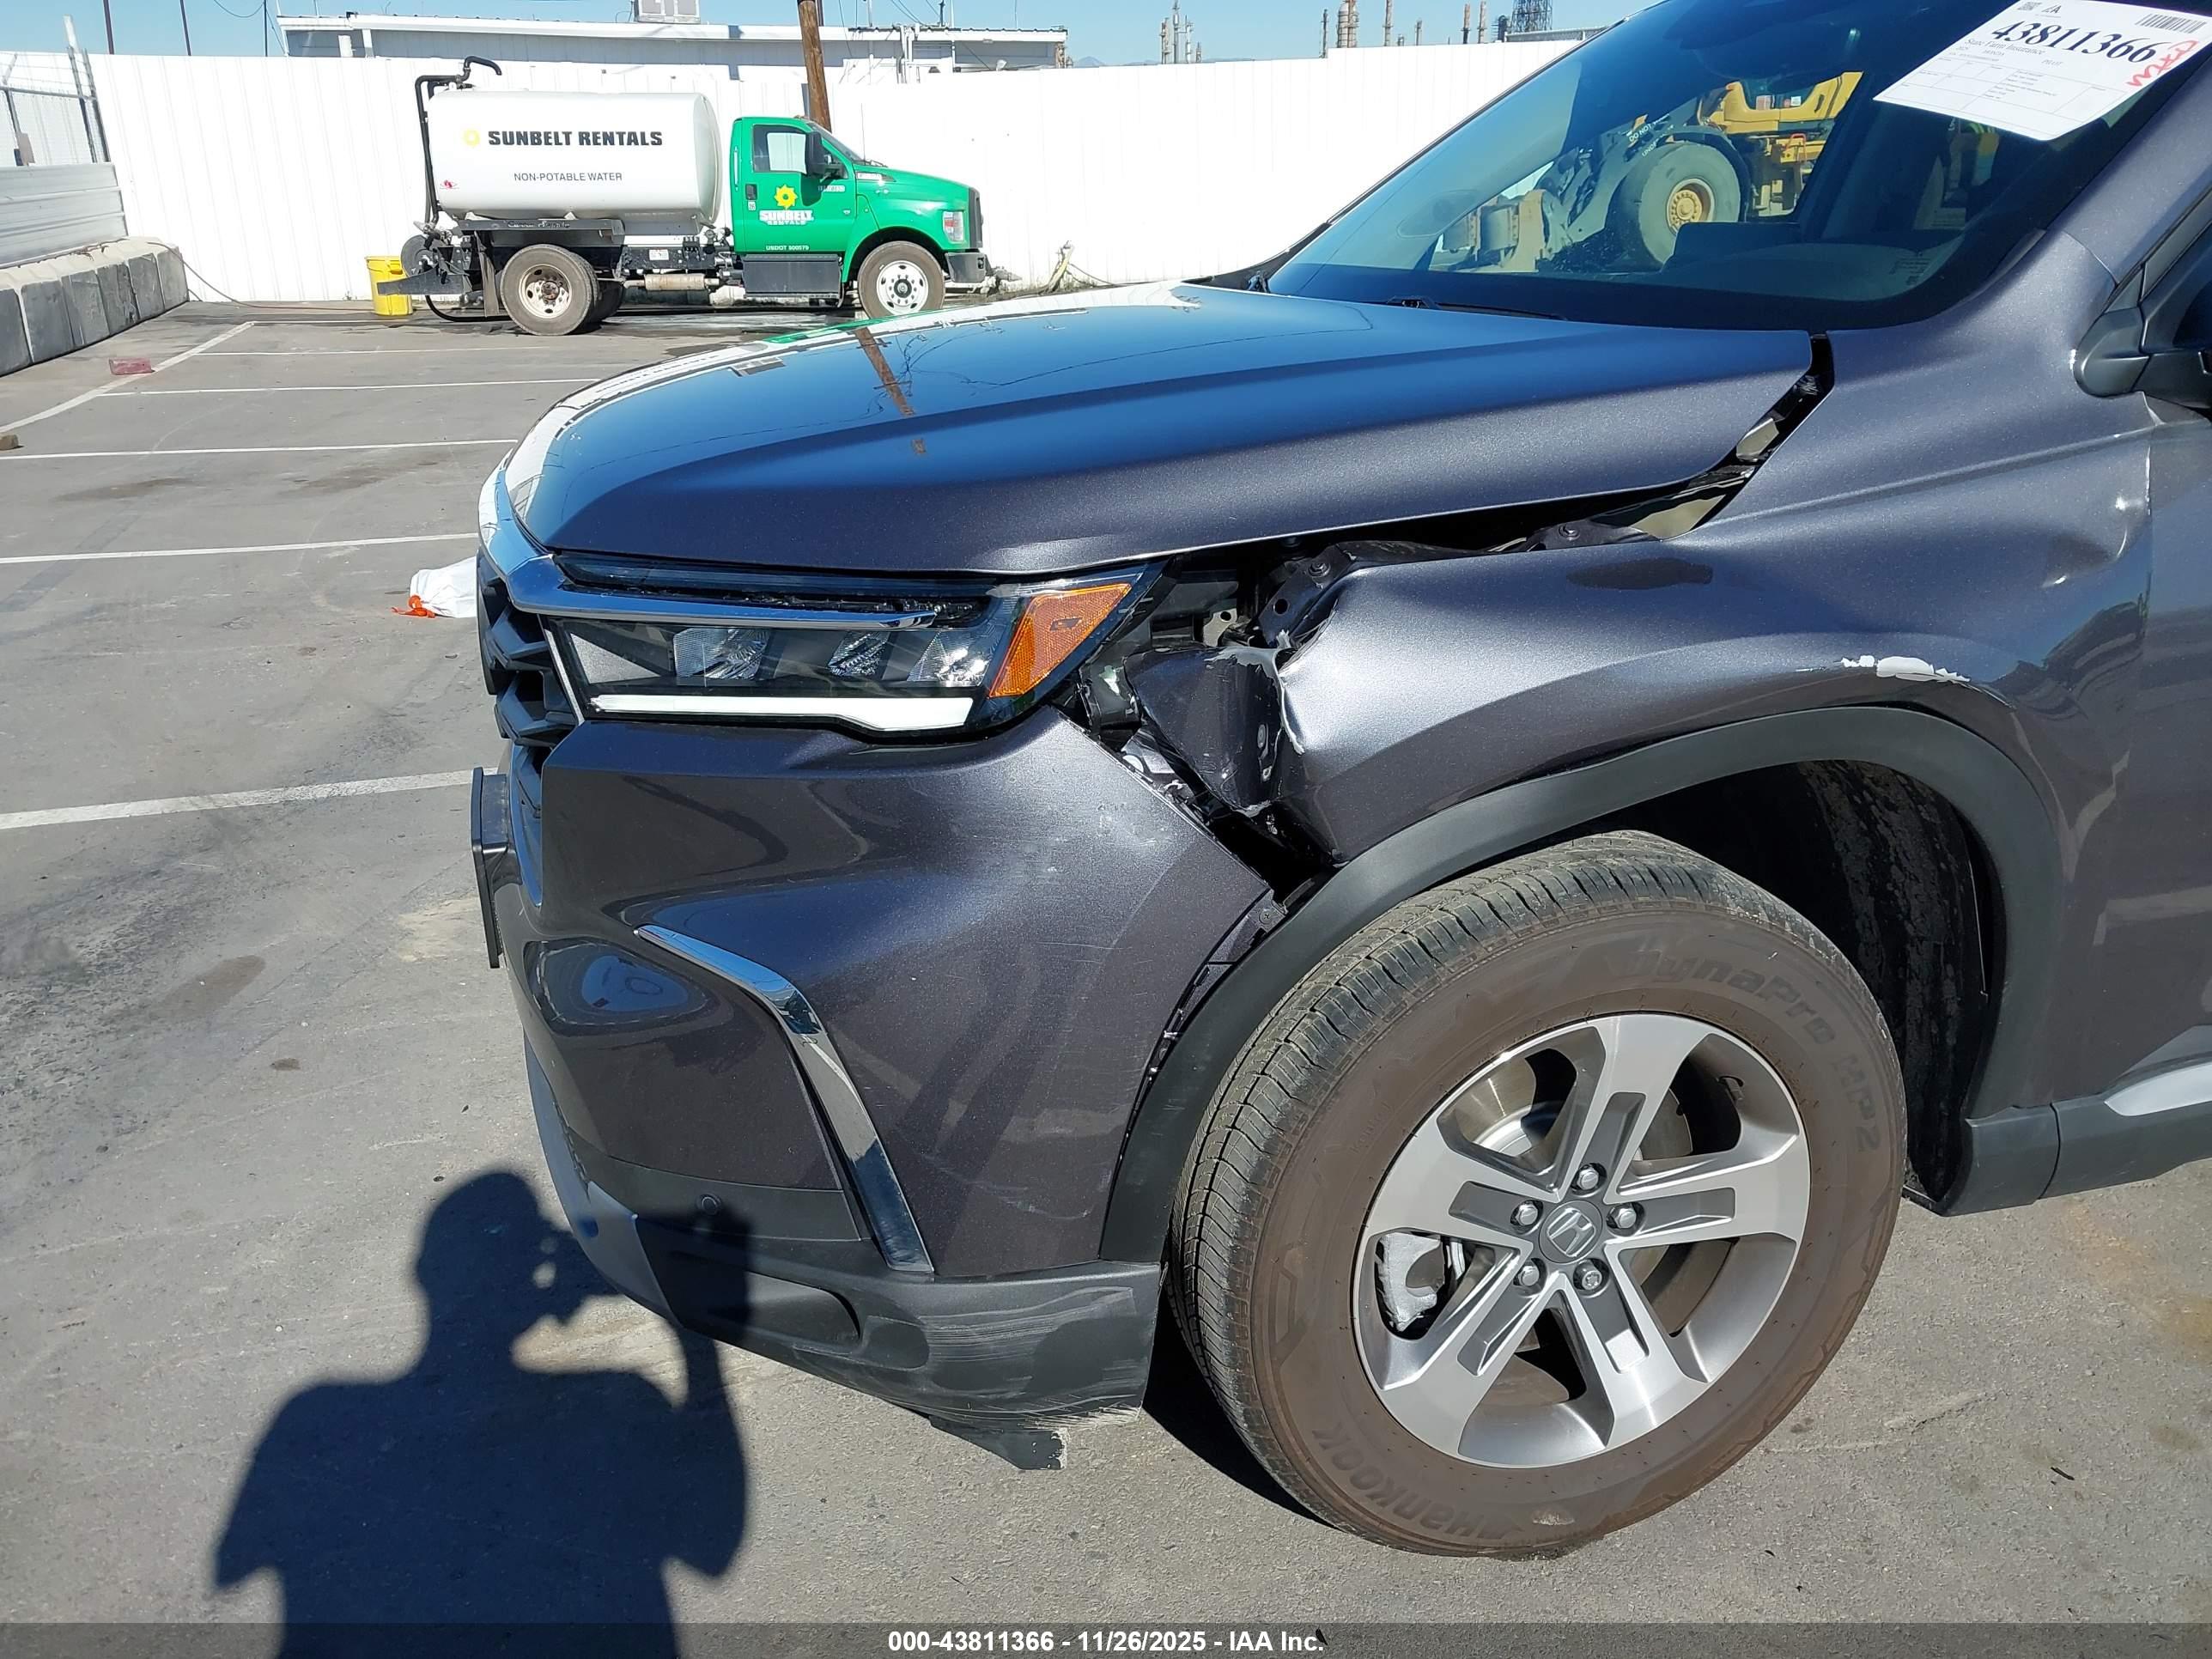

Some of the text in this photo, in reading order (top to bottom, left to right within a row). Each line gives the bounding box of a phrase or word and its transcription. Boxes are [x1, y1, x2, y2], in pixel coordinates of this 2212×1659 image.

[1990, 21, 2172, 64] 43811366
[1638, 123, 1652, 136] NOT
[488, 131, 663, 146] SUNBELT RENTALS
[514, 173, 623, 182] NON-POTABLE WATER
